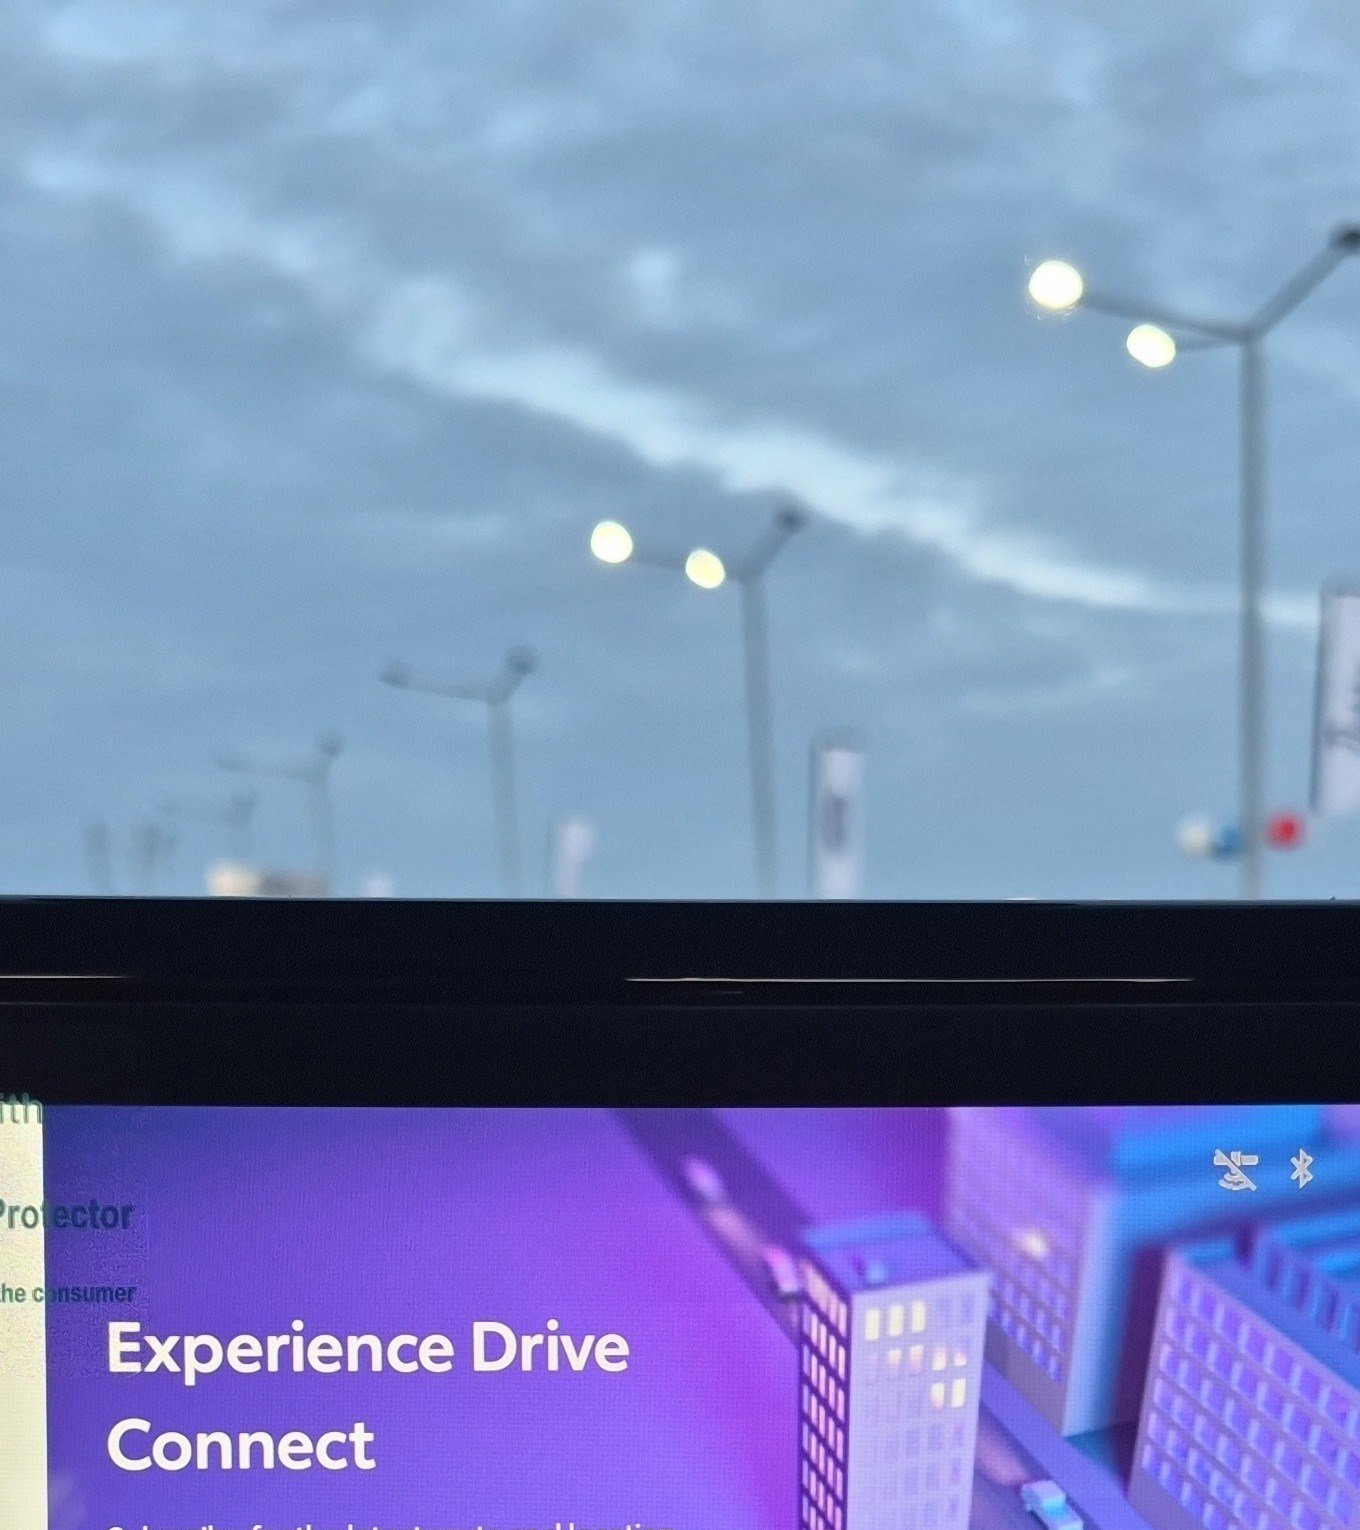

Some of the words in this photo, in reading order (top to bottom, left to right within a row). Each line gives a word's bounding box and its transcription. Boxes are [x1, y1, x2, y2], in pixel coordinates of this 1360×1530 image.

[31, 1285, 138, 1305] consumer
[107, 1319, 454, 1386] Experience
[472, 1319, 630, 1374] Drive
[106, 1418, 377, 1472] Connect
